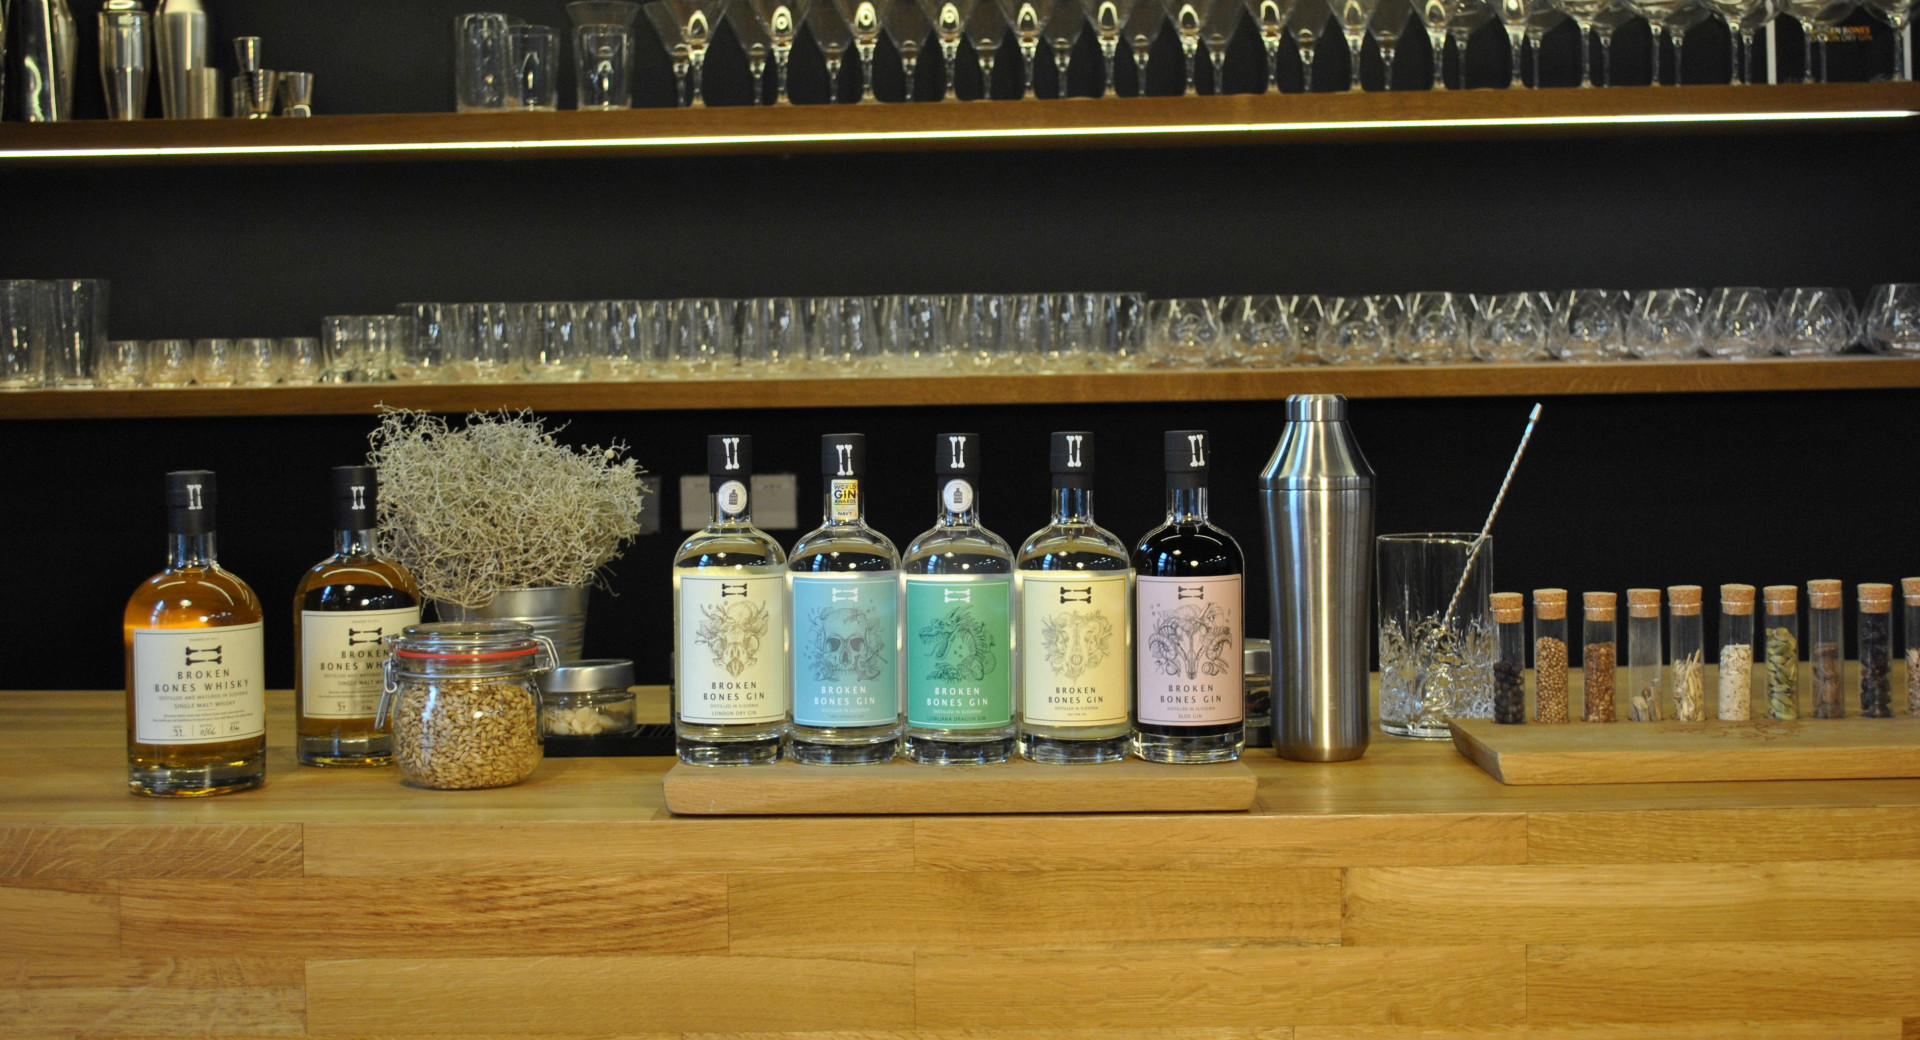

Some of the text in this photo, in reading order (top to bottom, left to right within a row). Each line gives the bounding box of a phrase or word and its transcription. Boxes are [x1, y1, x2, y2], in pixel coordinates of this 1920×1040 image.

[834, 489, 857, 499] GIN
[341, 649, 389, 659] BROKEN
[320, 662, 358, 671] BONES
[177, 669, 230, 680] BROKEN
[154, 679, 250, 693] BONES WHISKY
[711, 681, 757, 690] BROKEN
[821, 686, 867, 694] BROKEN
[1055, 686, 1096, 694] BROKEN
[1168, 684, 1214, 693] BROKEN
[703, 691, 765, 701] BONES GIN
[934, 687, 980, 696] BROKEN
[814, 696, 876, 706] BONES GIN
[926, 697, 988, 707] BONES GIN
[1048, 696, 1104, 704] BONES GIN
[1160, 695, 1222, 703] BONES GIN
[174, 702, 195, 710] SINGLE
[196, 701, 214, 709] MALT
